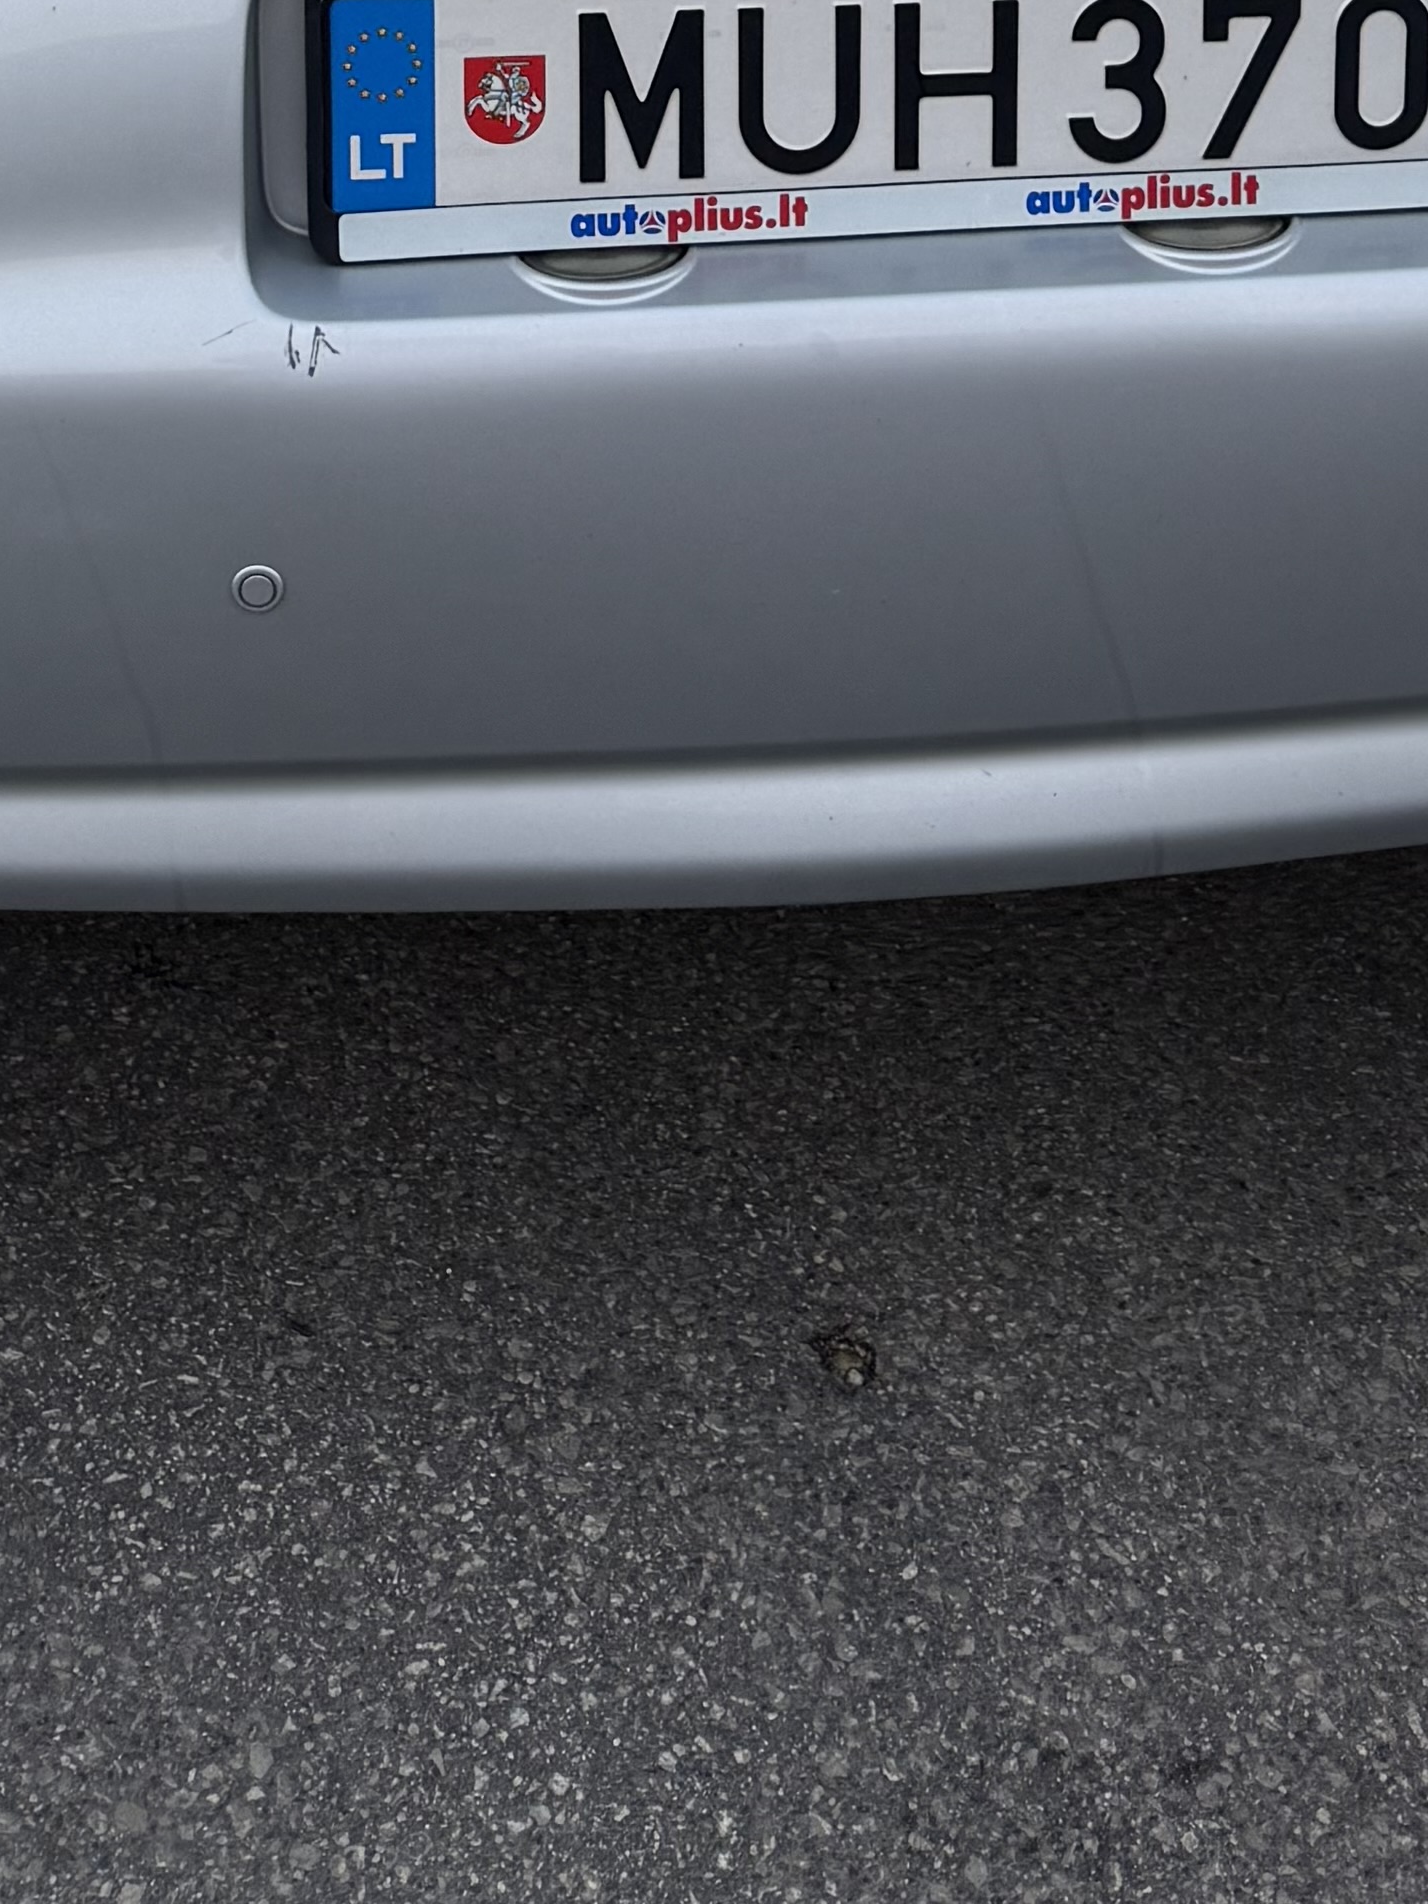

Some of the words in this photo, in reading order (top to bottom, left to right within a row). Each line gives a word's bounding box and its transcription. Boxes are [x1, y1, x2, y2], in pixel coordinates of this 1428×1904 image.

[578, 0, 1019, 183] MUH
[350, 133, 417, 180] LT
[570, 194, 808, 243] autoplius.lt
[1026, 172, 1259, 219] autoplius.lt
